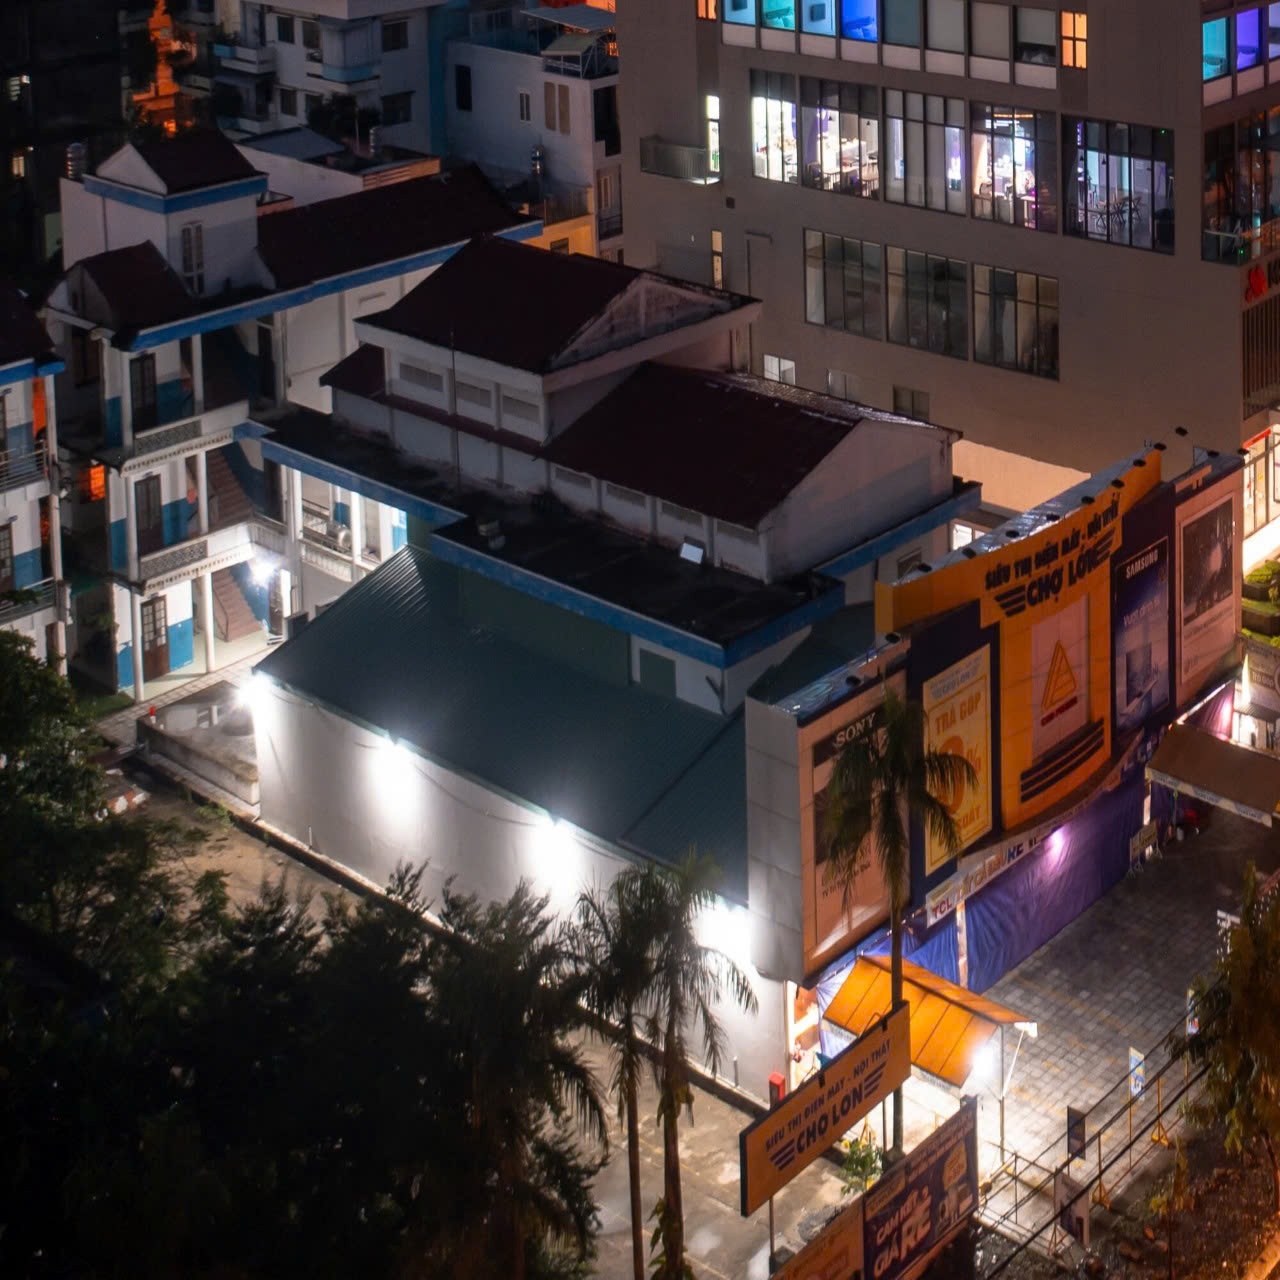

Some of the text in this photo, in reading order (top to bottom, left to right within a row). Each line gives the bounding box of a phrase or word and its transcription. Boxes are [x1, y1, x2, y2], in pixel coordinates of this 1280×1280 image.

[1125, 548, 1159, 580] SAMSUNG
[834, 712, 876, 747] SONY
[932, 897, 953, 919] TCL
